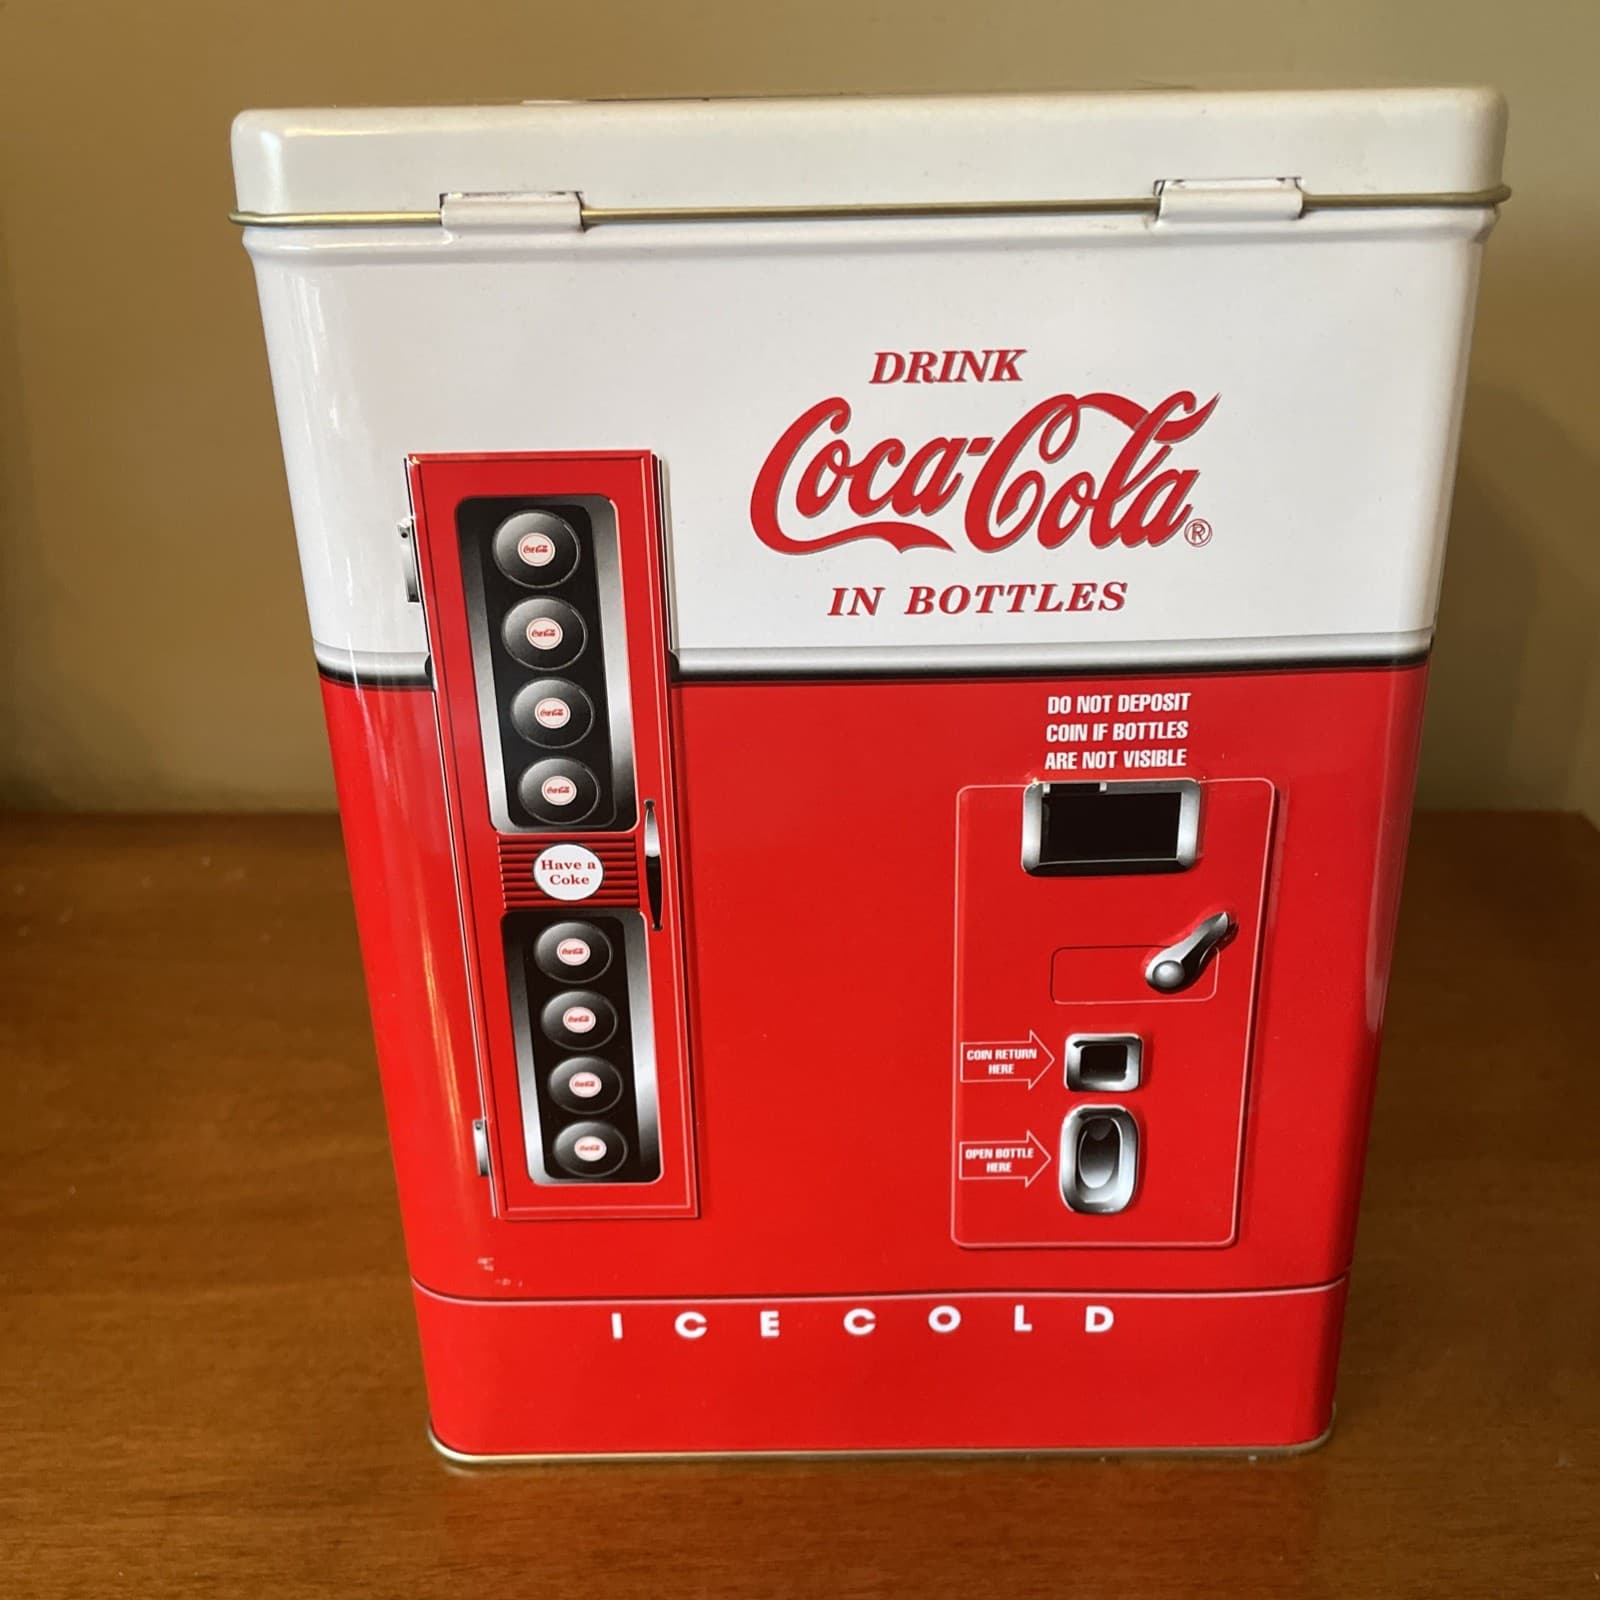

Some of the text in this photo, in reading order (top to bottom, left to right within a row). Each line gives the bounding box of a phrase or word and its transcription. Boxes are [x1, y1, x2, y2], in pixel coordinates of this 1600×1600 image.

[869, 348, 1026, 385] DRINK
[749, 389, 1222, 556] Coca-Cola
[827, 581, 1129, 617] IN BOTTLES
[1047, 692, 1192, 715] DO NOT DEPOSIT
[1046, 720, 1190, 743] COIN IF BOTTLES
[1044, 748, 1188, 771] ARE NOT VISIBLE
[541, 859, 596, 870] Have a
[549, 874, 590, 886] Coke
[966, 1048, 1038, 1061] COIN RETURN
[988, 1063, 1015, 1075] HERE
[964, 1147, 1034, 1160] OPEN BOTTLE
[986, 1162, 1012, 1173] HERE
[611, 1304, 1115, 1340] ICE COLD
